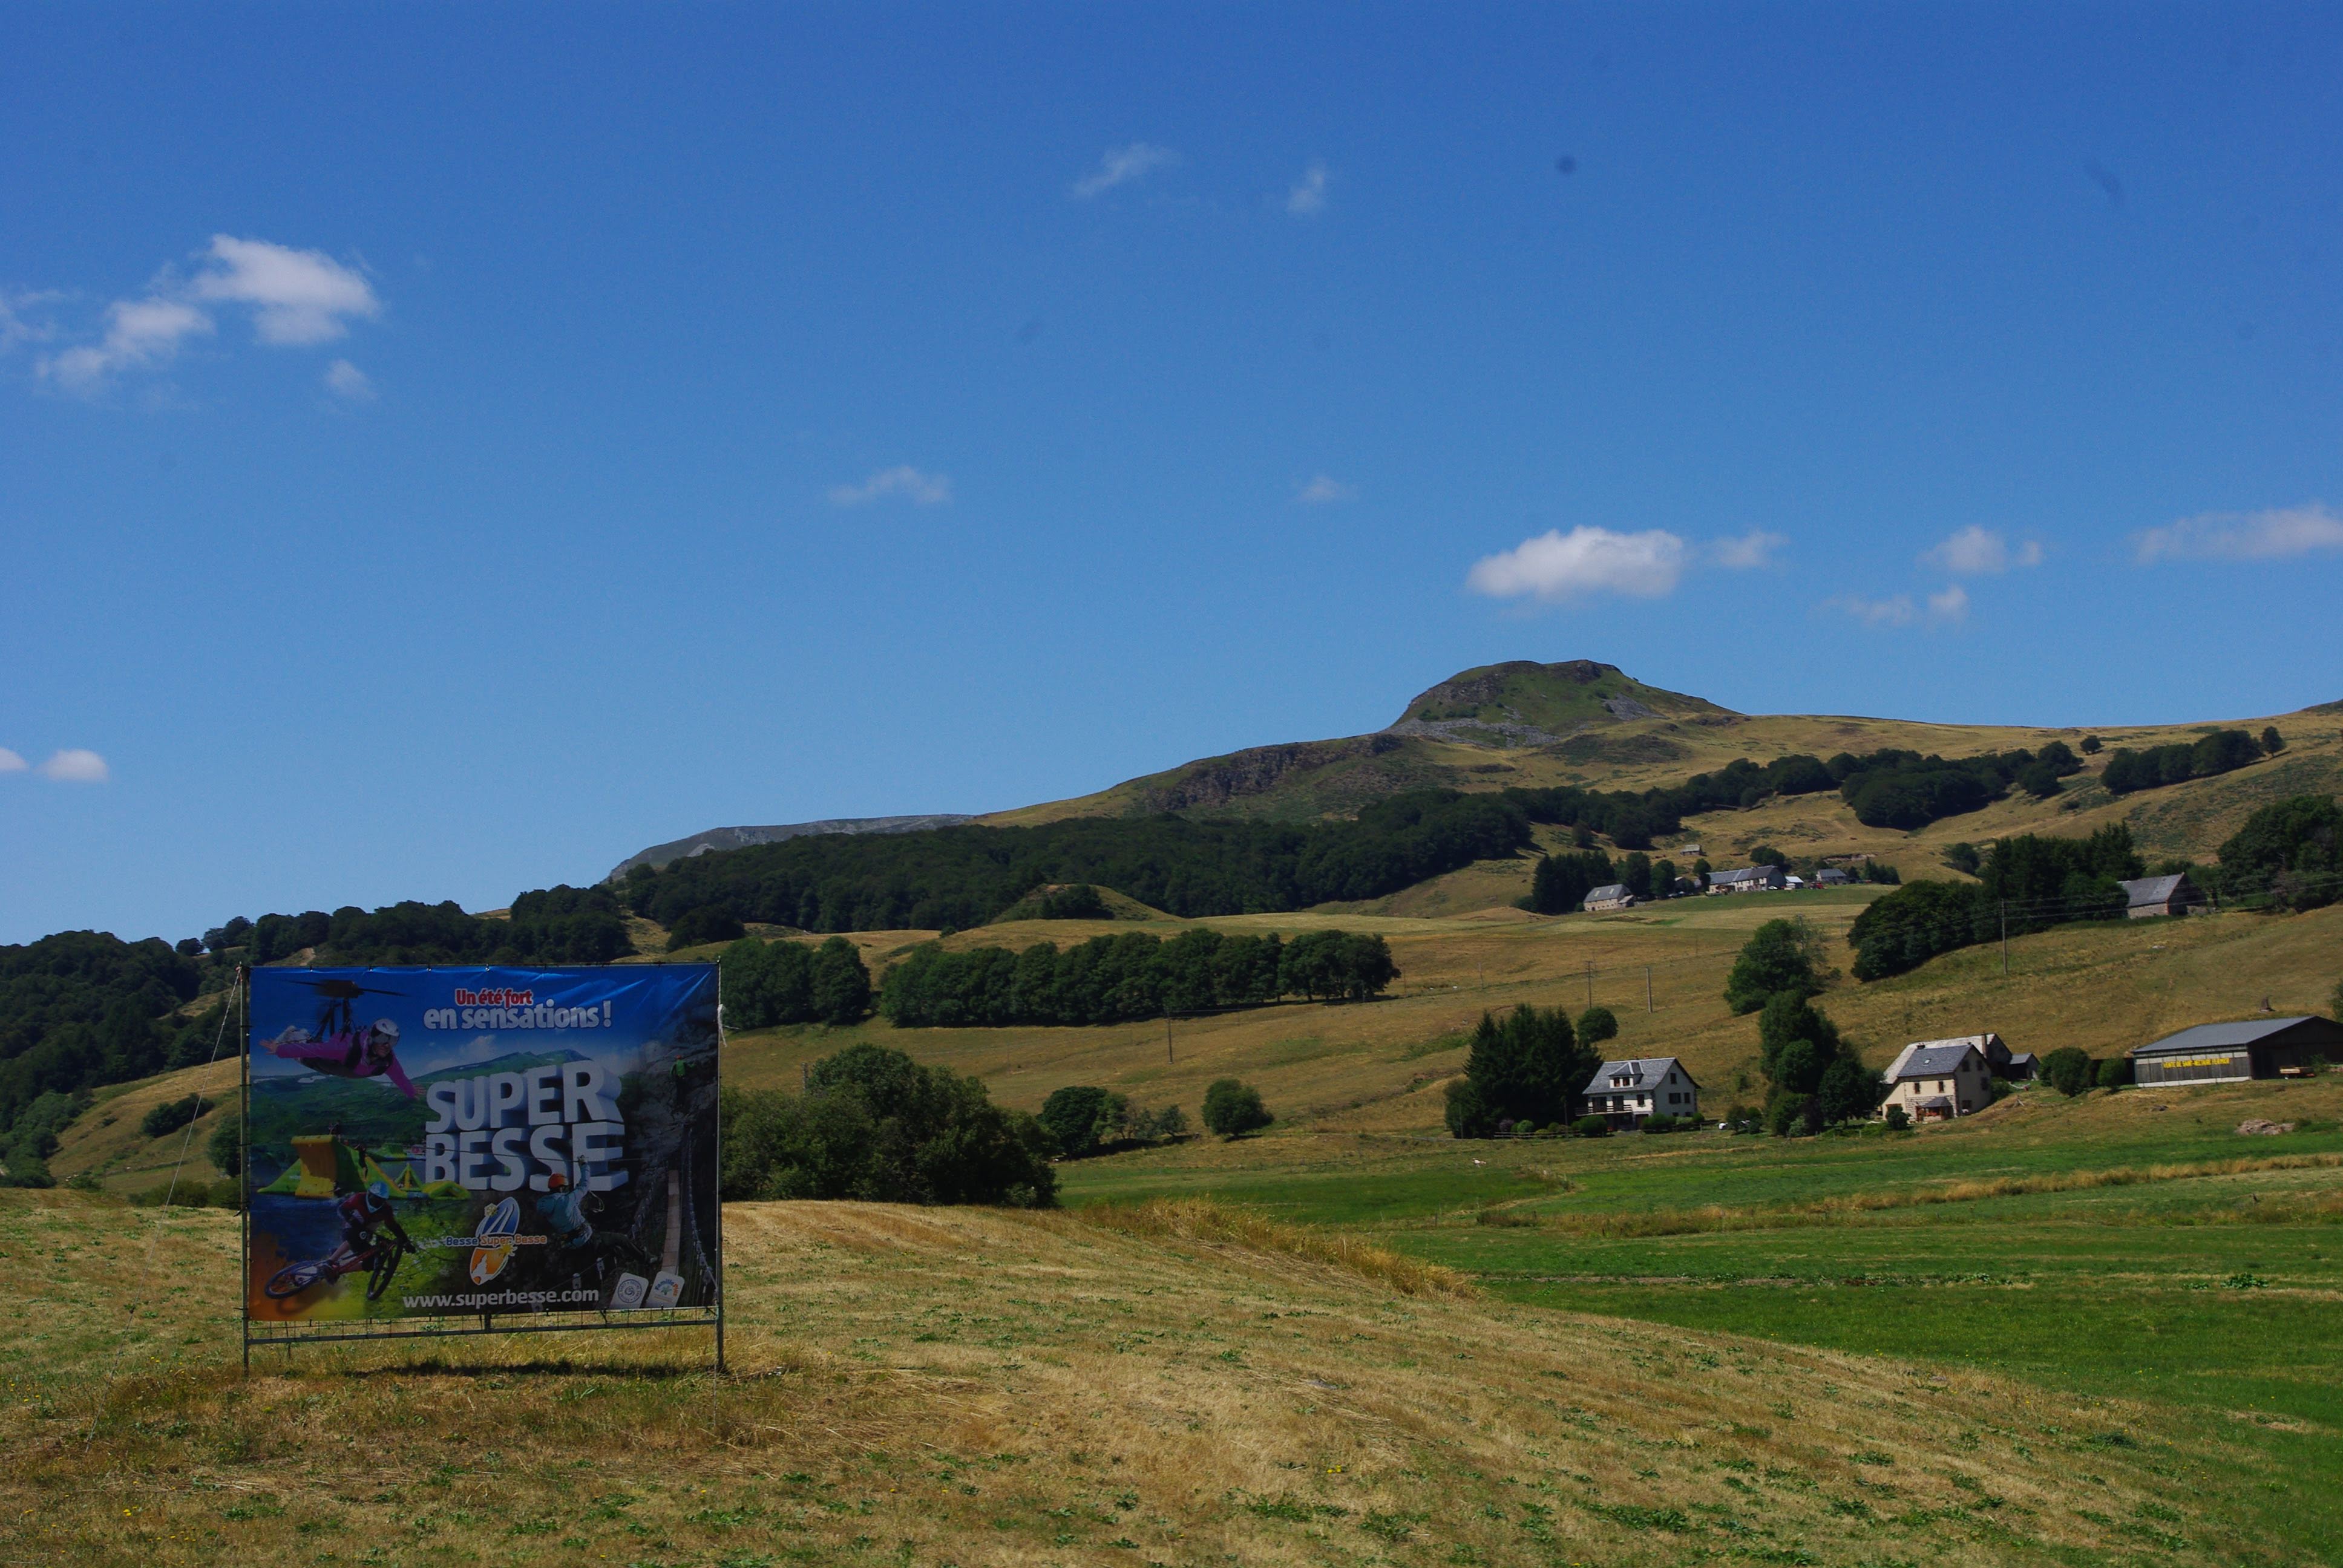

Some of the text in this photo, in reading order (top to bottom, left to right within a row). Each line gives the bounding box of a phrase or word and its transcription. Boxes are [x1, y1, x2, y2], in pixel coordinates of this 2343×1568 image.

[455, 987, 533, 1008] Un été fort
[424, 1008, 457, 1030] en
[461, 999, 600, 1030] sensations
[425, 1059, 624, 1134] SUPER
[425, 1121, 629, 1192] BESSE
[446, 1234, 547, 1247] Besse Super Besse
[402, 1289, 599, 1309] www.superbesse.com
